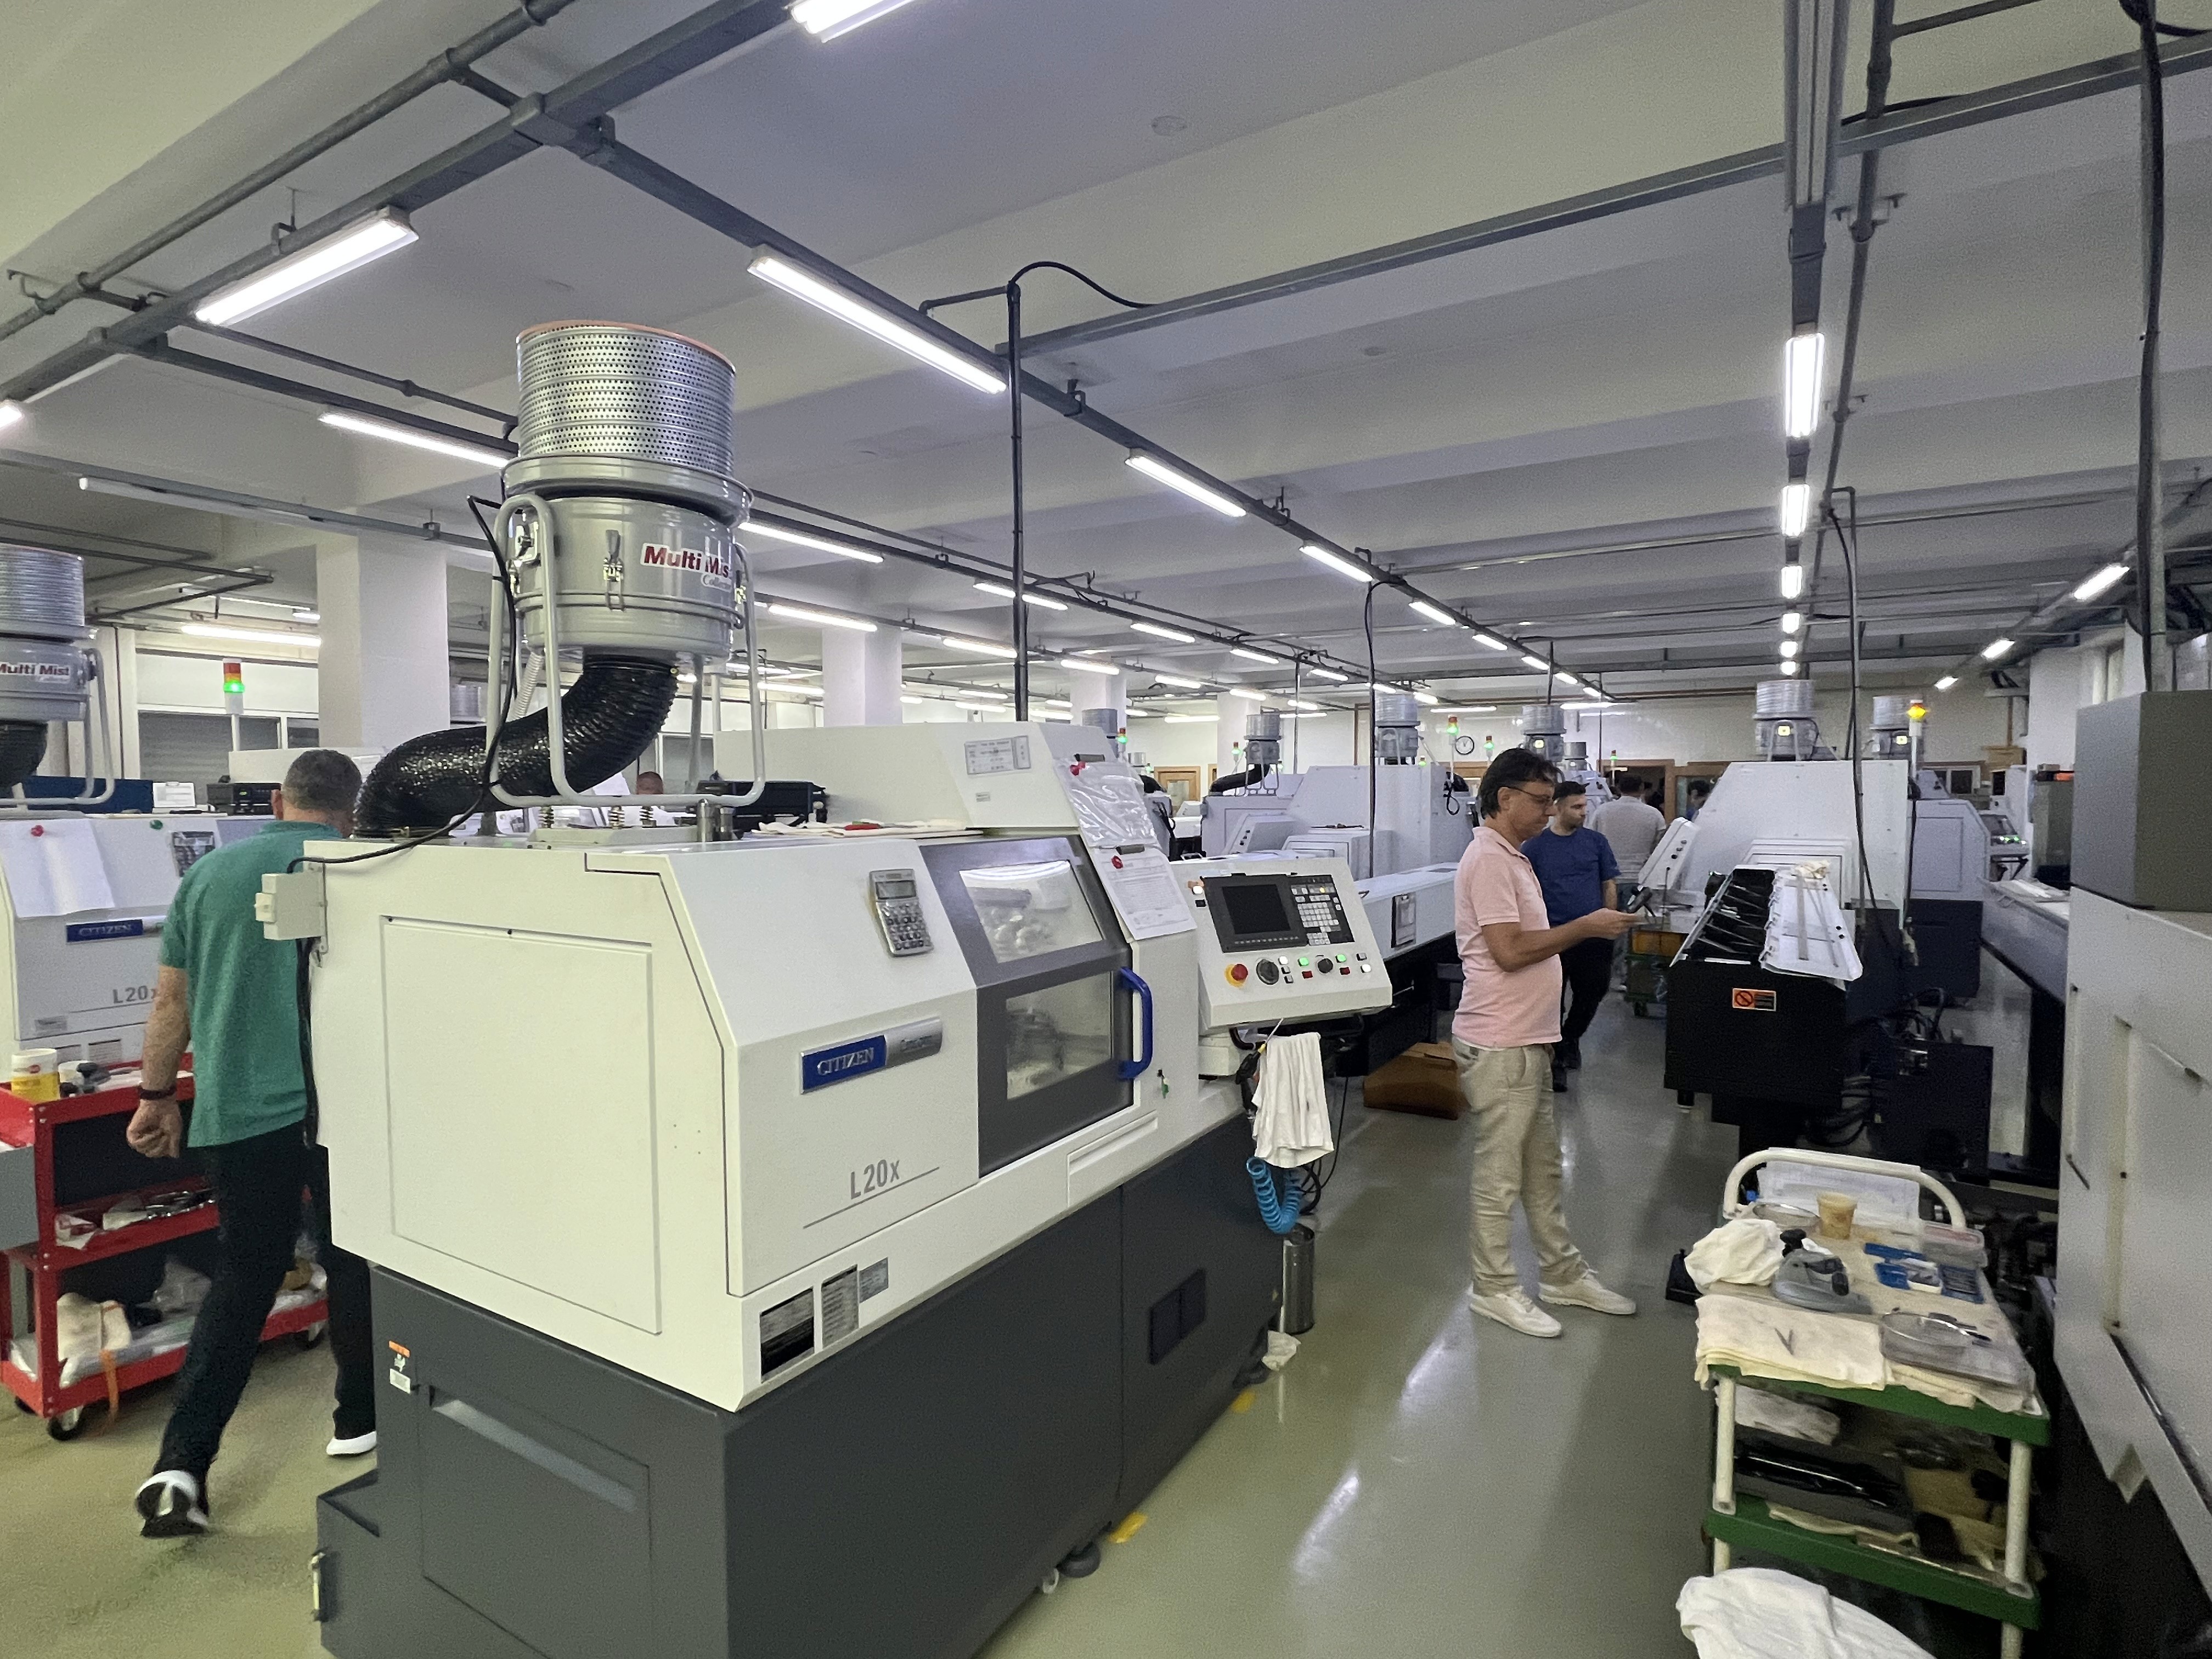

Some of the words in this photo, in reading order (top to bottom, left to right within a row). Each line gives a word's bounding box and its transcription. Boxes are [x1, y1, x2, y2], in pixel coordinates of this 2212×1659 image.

[644, 546, 702, 570] Multi
[705, 556, 730, 578] Ms
[40, 665, 69, 676] Mist
[79, 924, 132, 936] CITIZEN
[817, 1047, 874, 1075] CITIZEN
[850, 1159, 900, 1200] L20x
